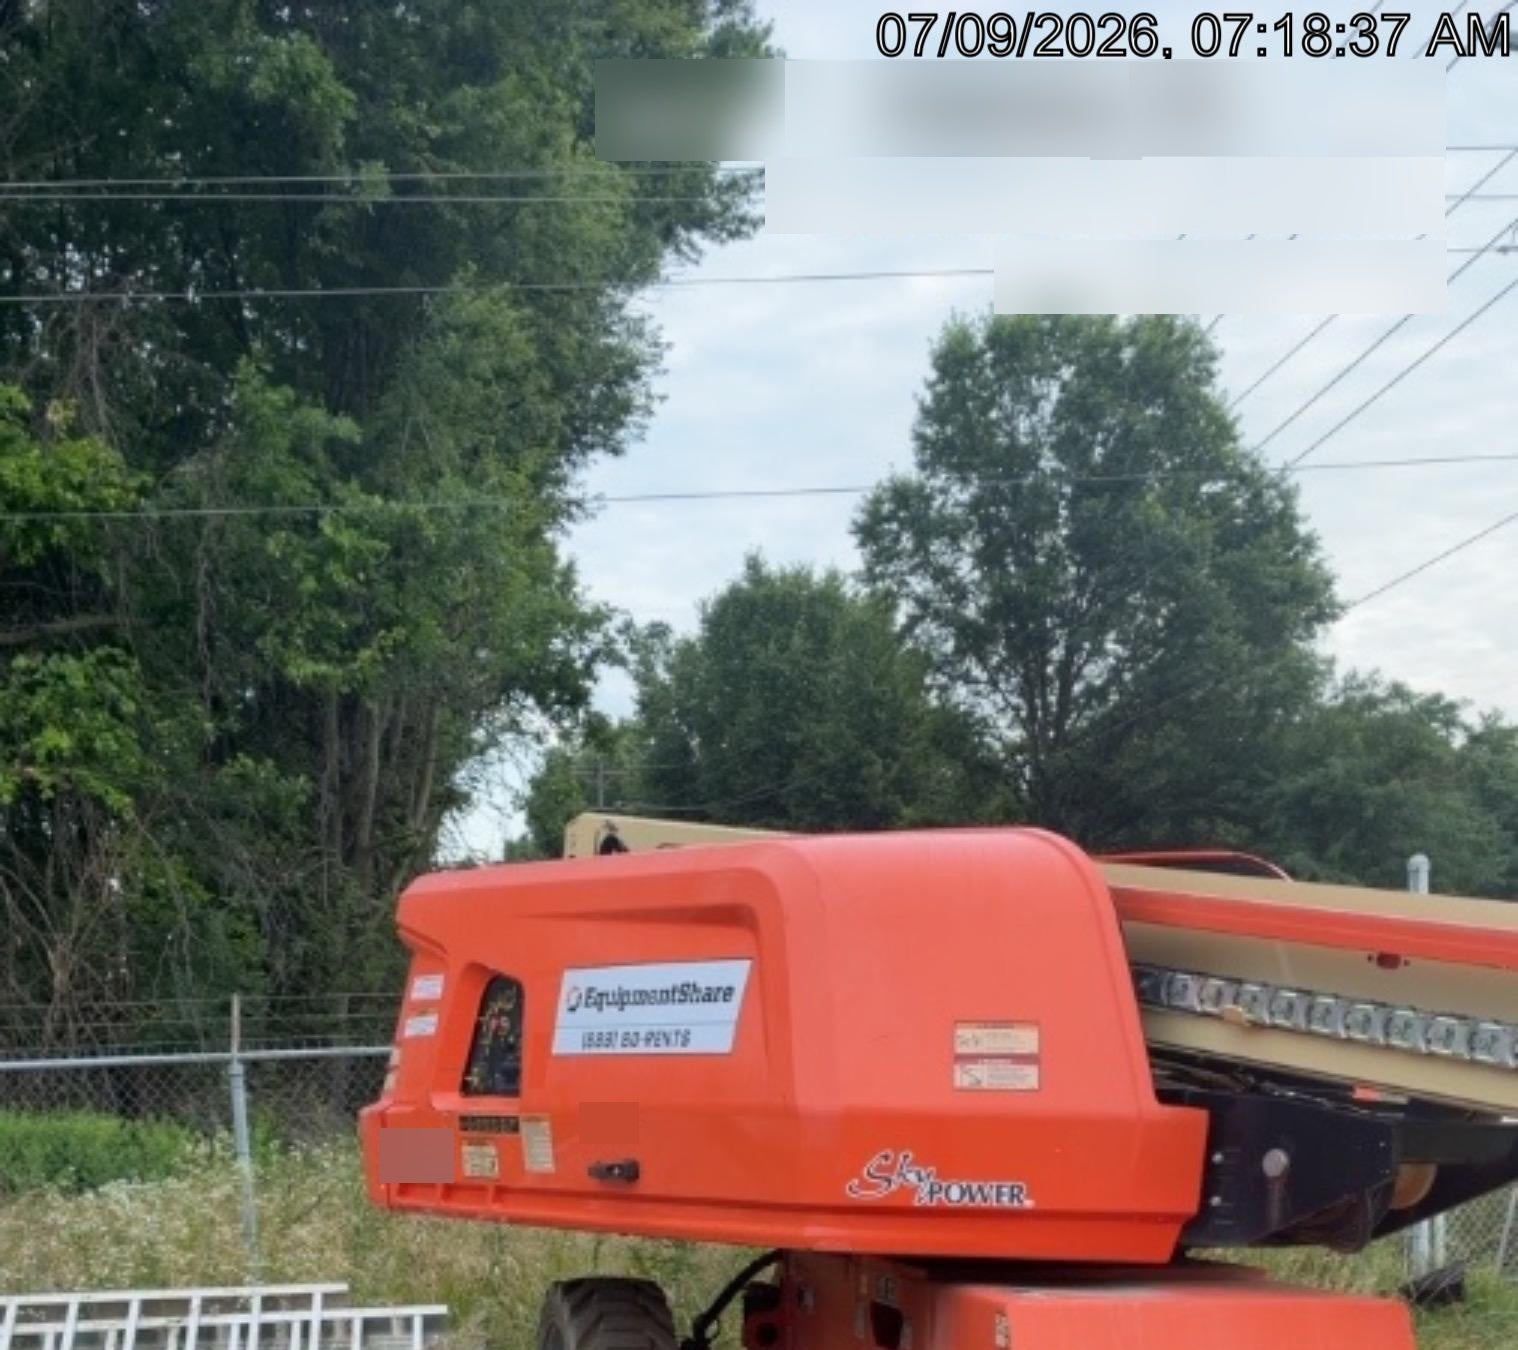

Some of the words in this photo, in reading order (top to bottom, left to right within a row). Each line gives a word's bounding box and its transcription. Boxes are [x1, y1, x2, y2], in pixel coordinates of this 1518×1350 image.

[583, 981, 736, 1012] EquipmentShare
[846, 1149, 935, 1205] Sky
[927, 1181, 1027, 1207] POWER
